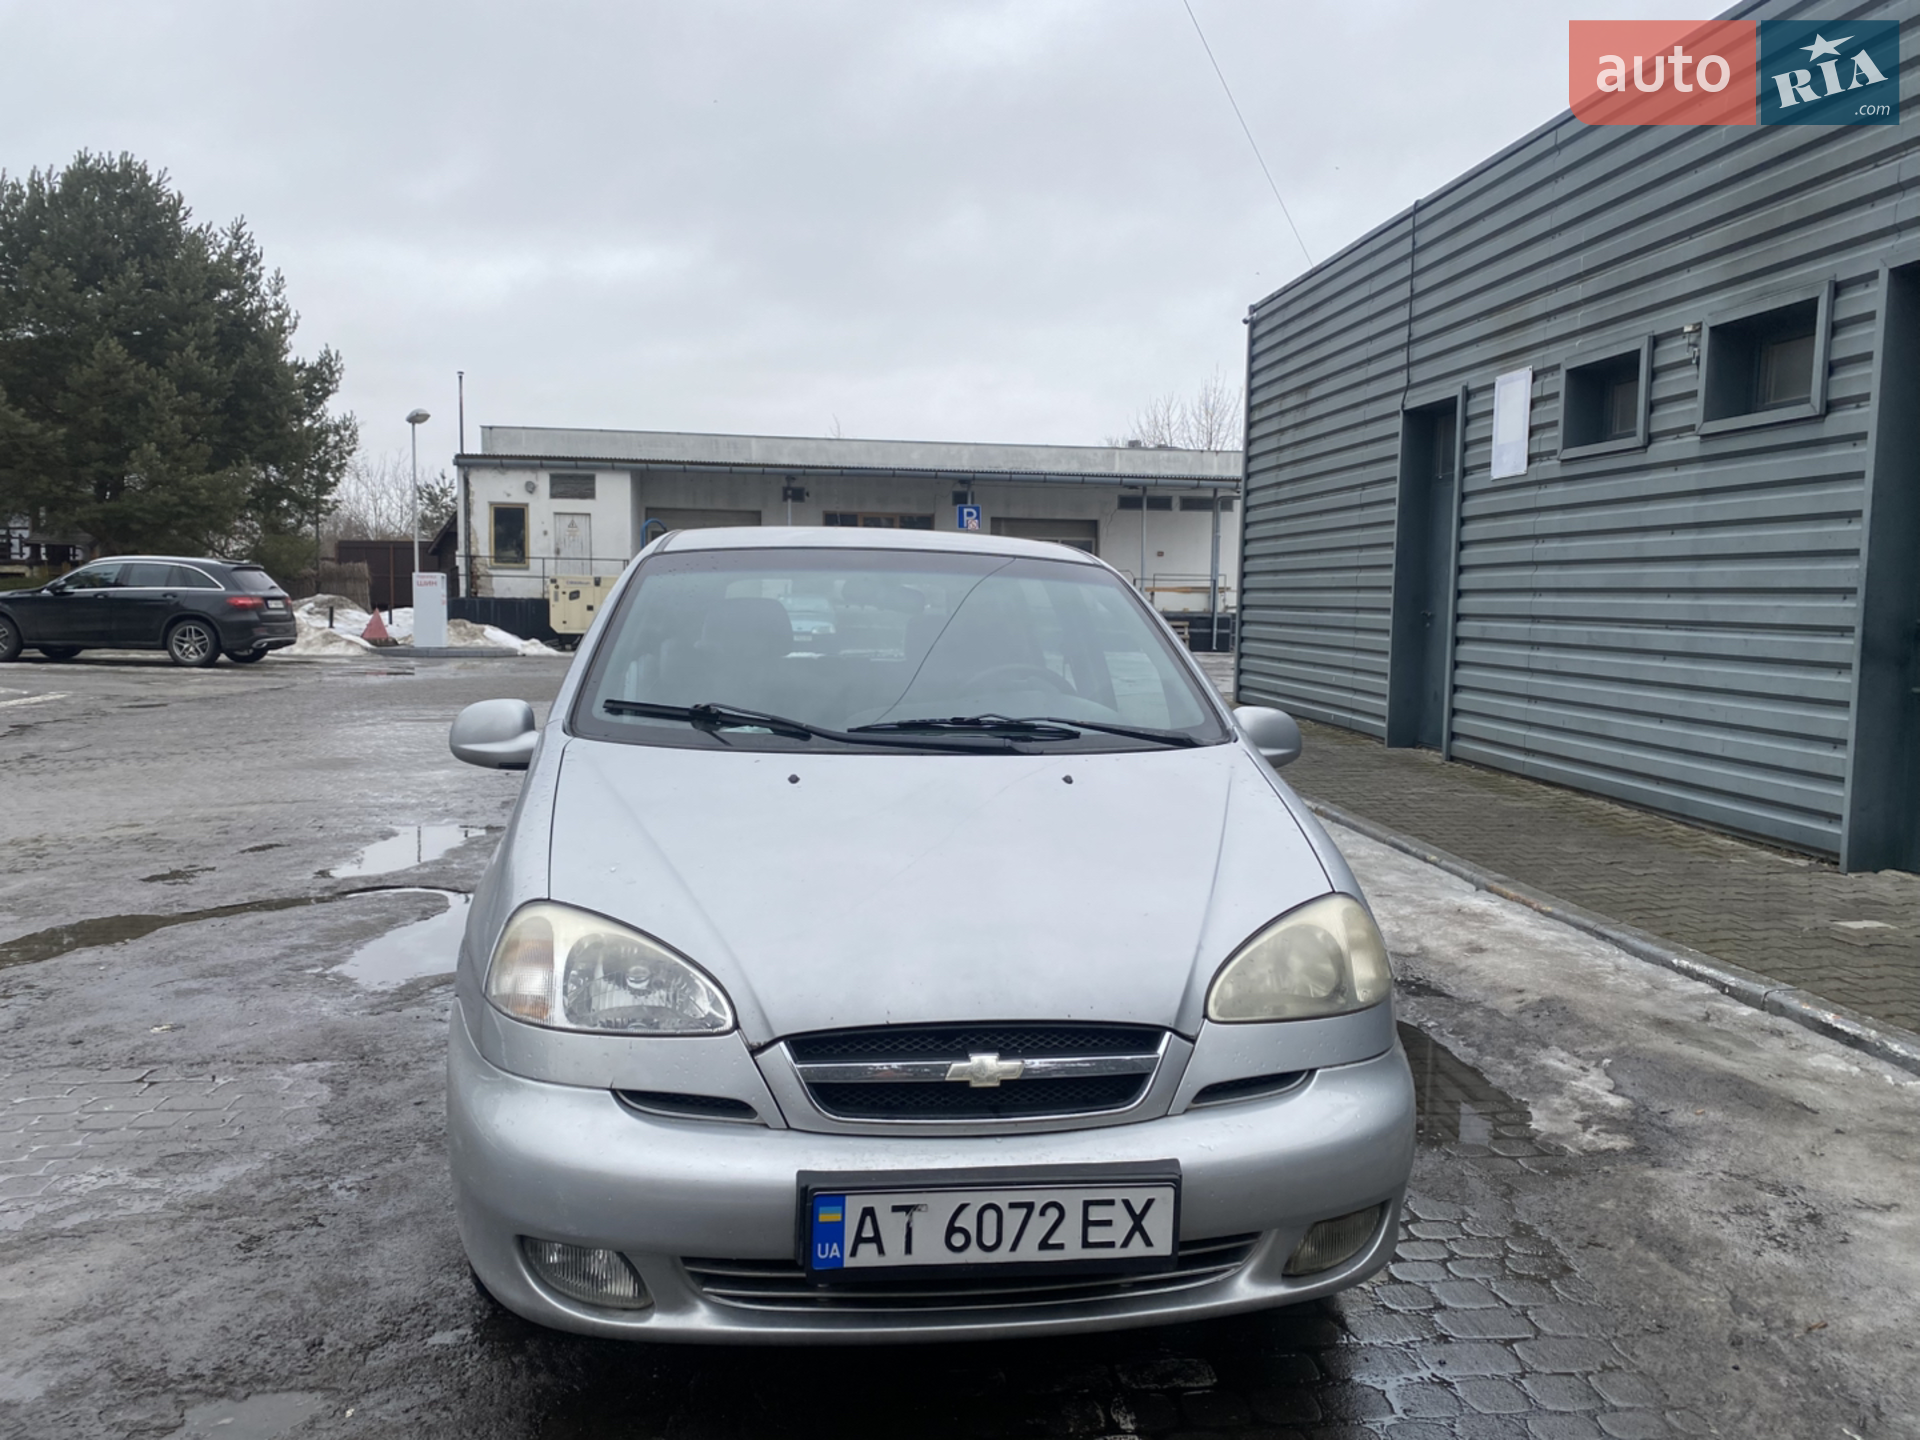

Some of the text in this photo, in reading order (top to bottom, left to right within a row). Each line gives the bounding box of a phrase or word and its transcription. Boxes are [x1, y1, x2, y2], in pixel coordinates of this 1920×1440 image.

[963, 507, 977, 528] P
[849, 1197, 1156, 1258] AT 6072 EX
[817, 1243, 841, 1259] UA
